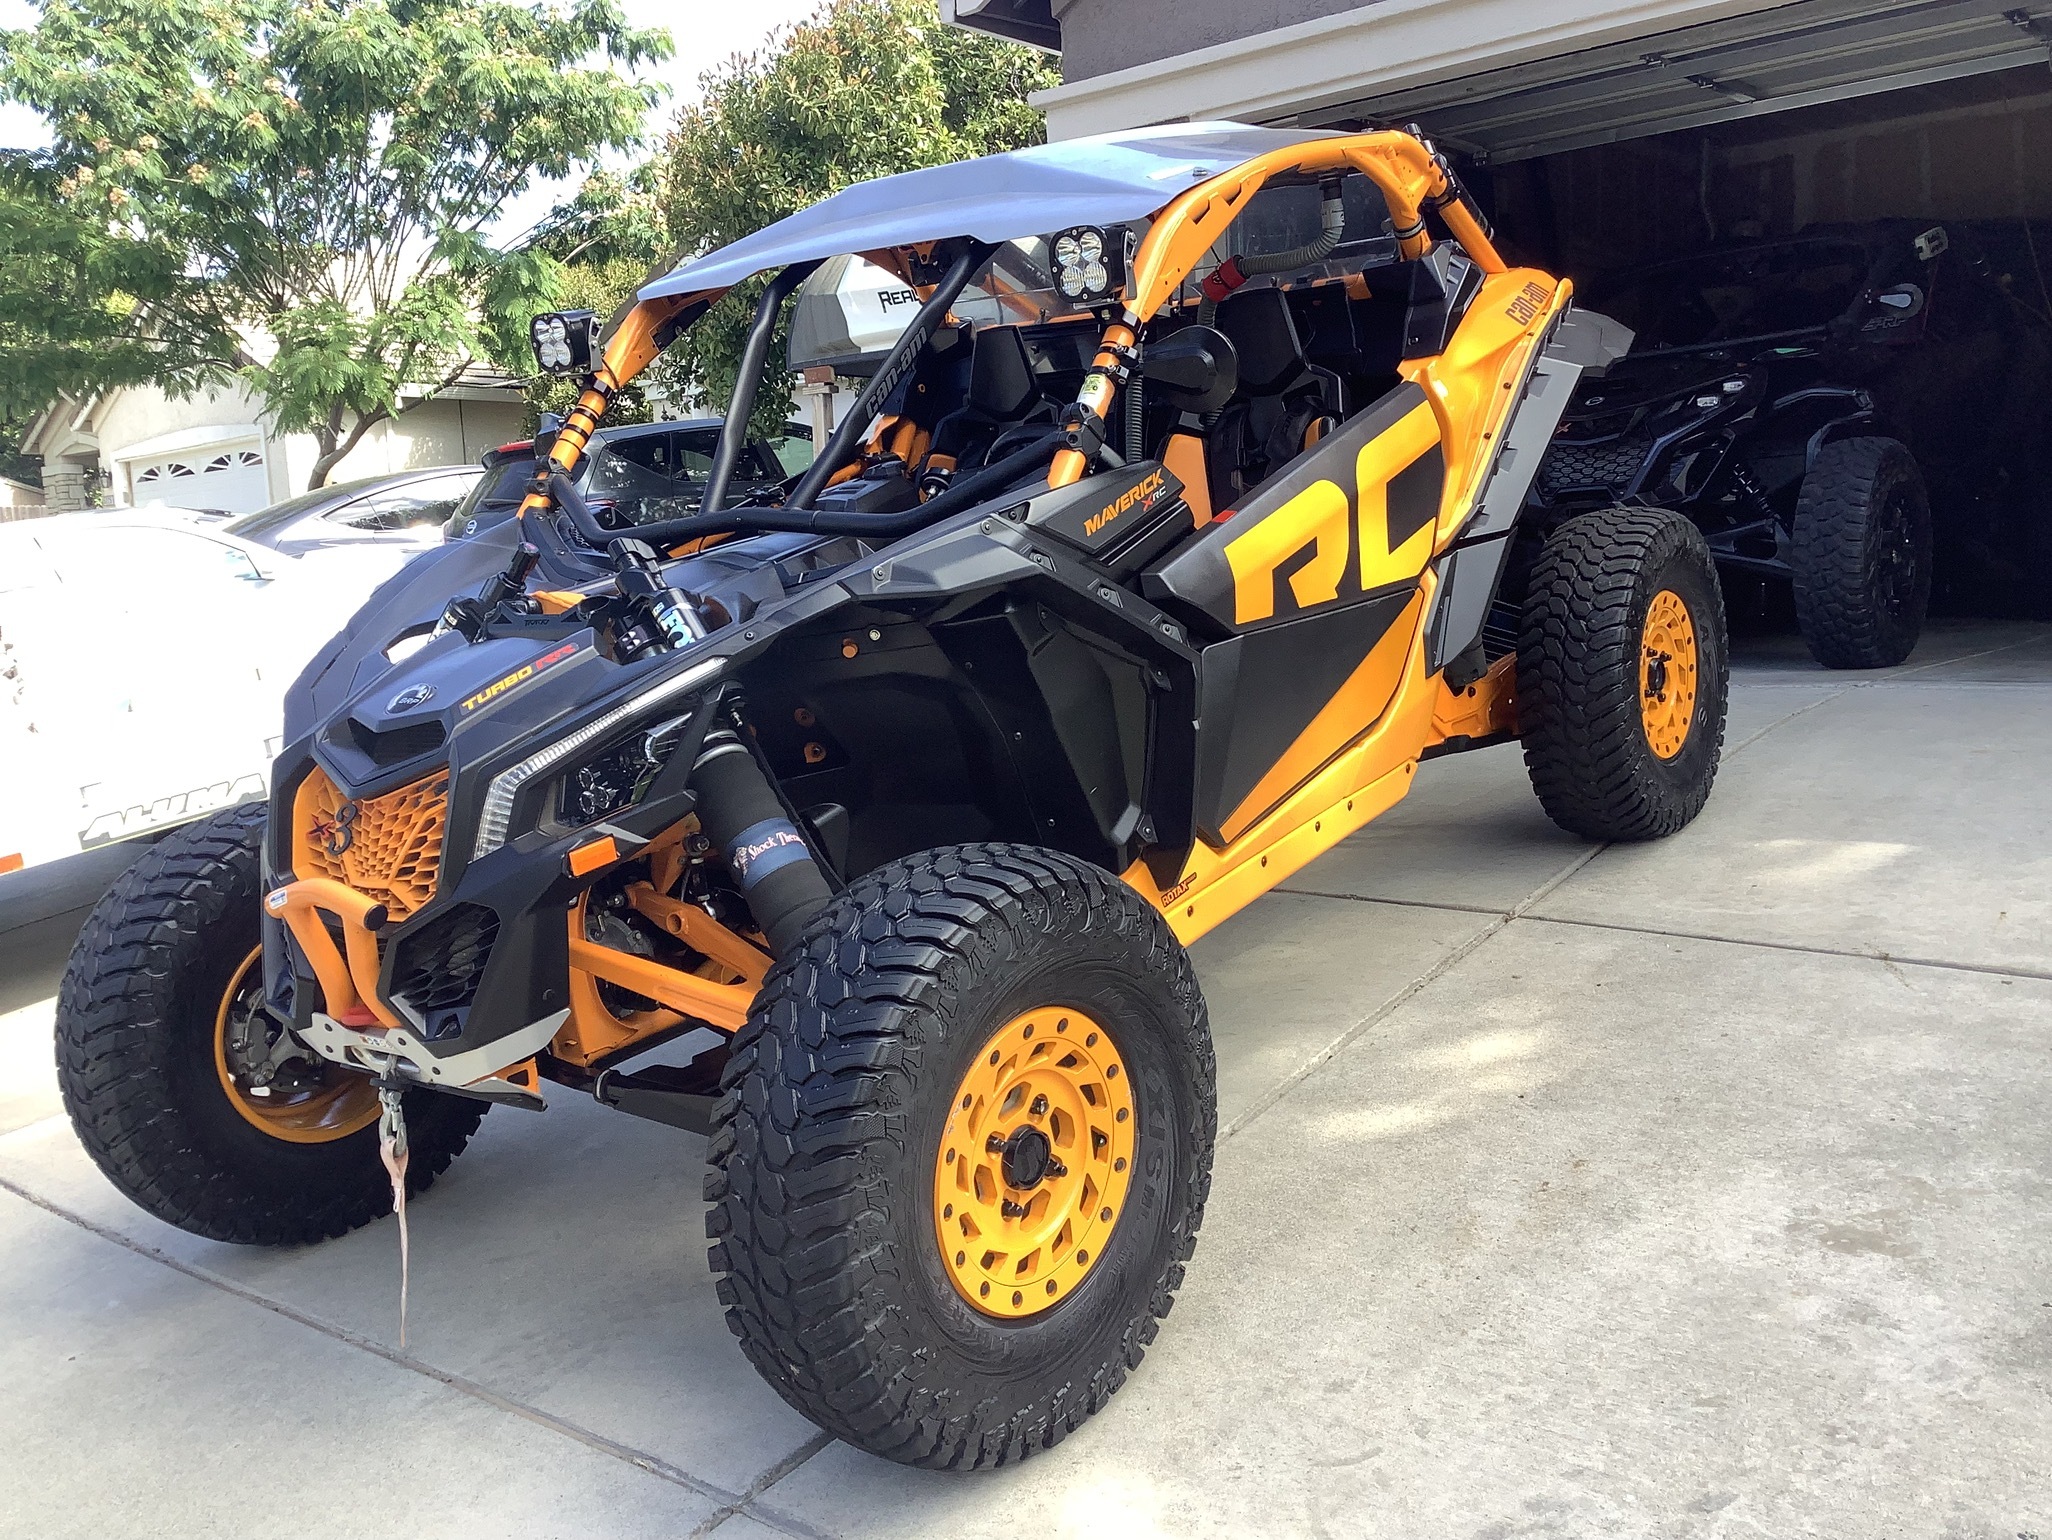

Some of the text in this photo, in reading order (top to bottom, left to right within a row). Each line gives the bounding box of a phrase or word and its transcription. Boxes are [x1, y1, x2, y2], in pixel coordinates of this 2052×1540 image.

[1504, 281, 1550, 326] can-am
[864, 325, 928, 420] can-am
[1083, 467, 1165, 537] MAVERICK
[461, 665, 533, 711] TURBO
[81, 773, 267, 841] ALUMA
[748, 836, 778, 861] Shock
[1161, 880, 1189, 907] ROTAX
